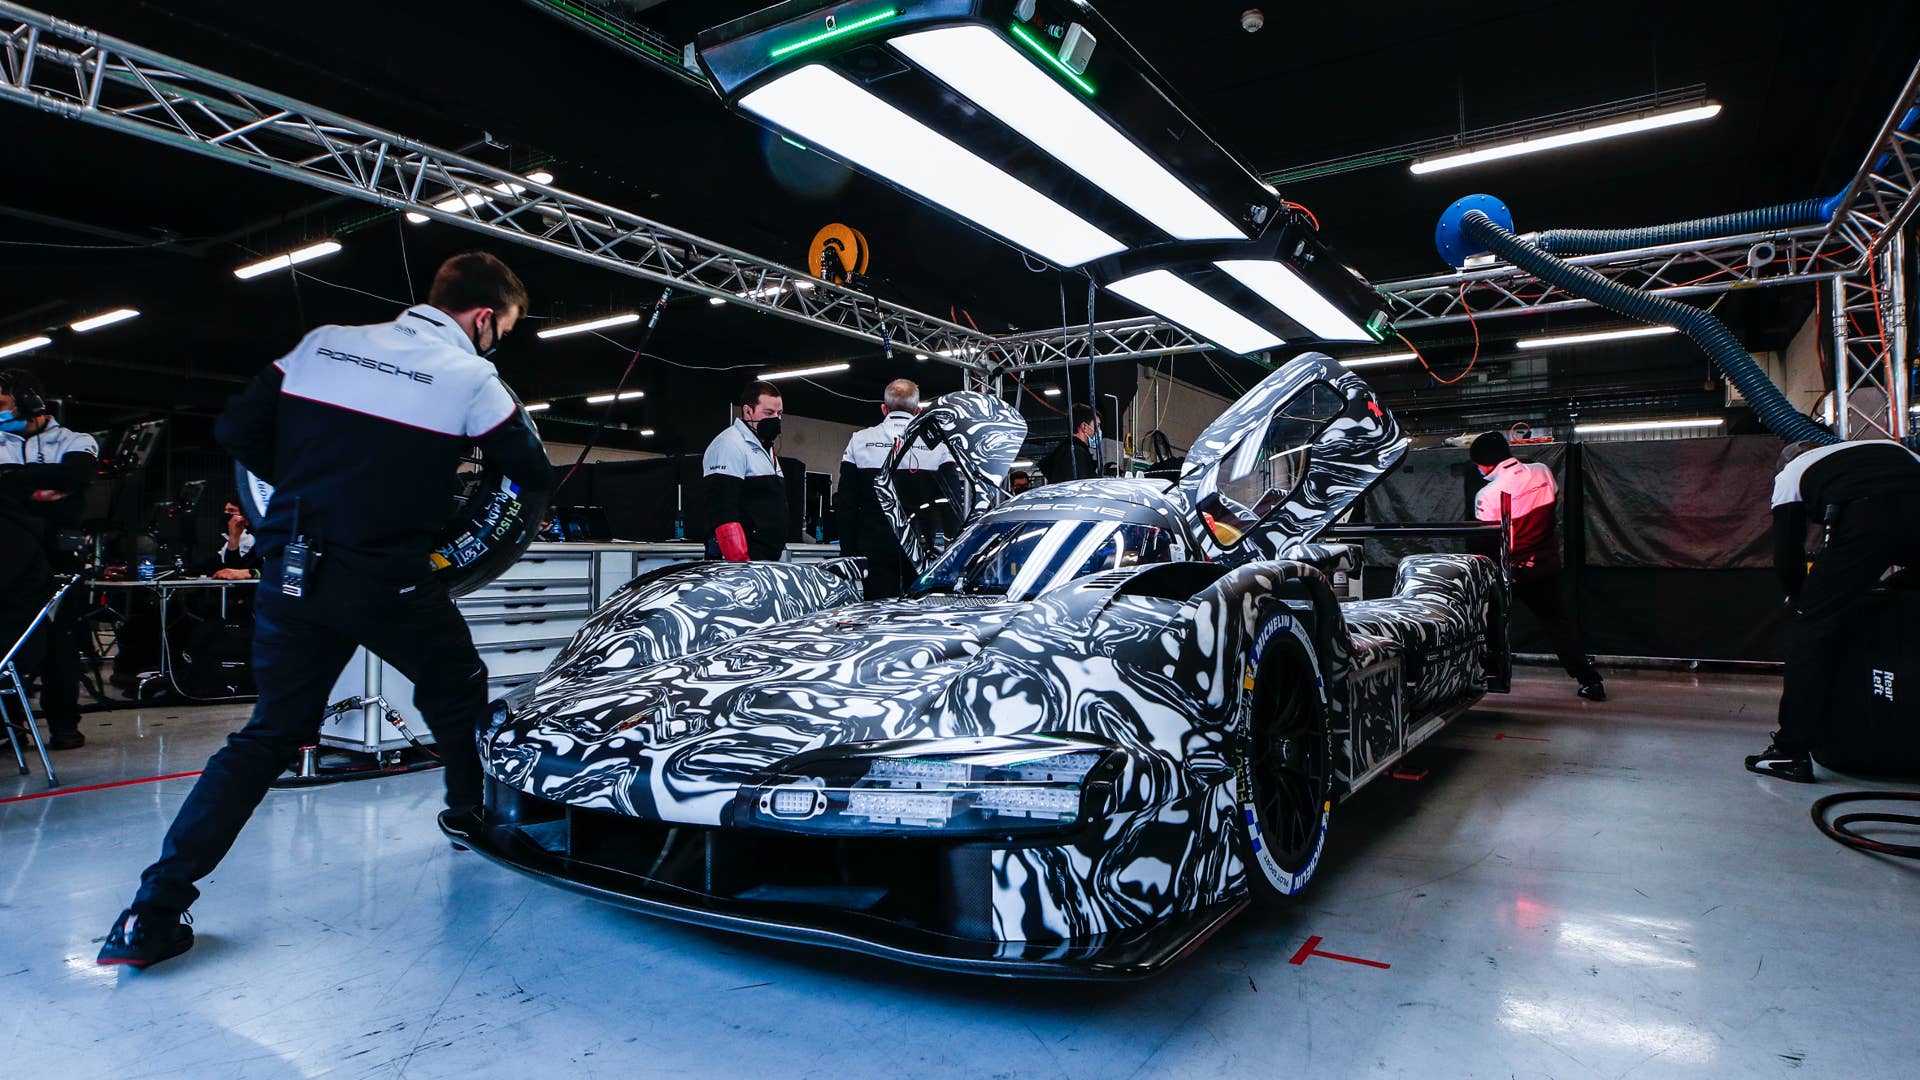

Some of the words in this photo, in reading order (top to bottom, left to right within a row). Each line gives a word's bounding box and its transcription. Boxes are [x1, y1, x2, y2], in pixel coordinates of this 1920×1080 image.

[316, 347, 434, 385] PORSCHE
[865, 442, 929, 451] PORHE
[256, 479, 271, 504] PORT
[1255, 614, 1290, 660] MICHELIN
[1872, 668, 1884, 696] Left
[1883, 671, 1894, 702] Rear
[1263, 854, 1279, 878] SPORT
[1293, 830, 1325, 891] MICHELIN
